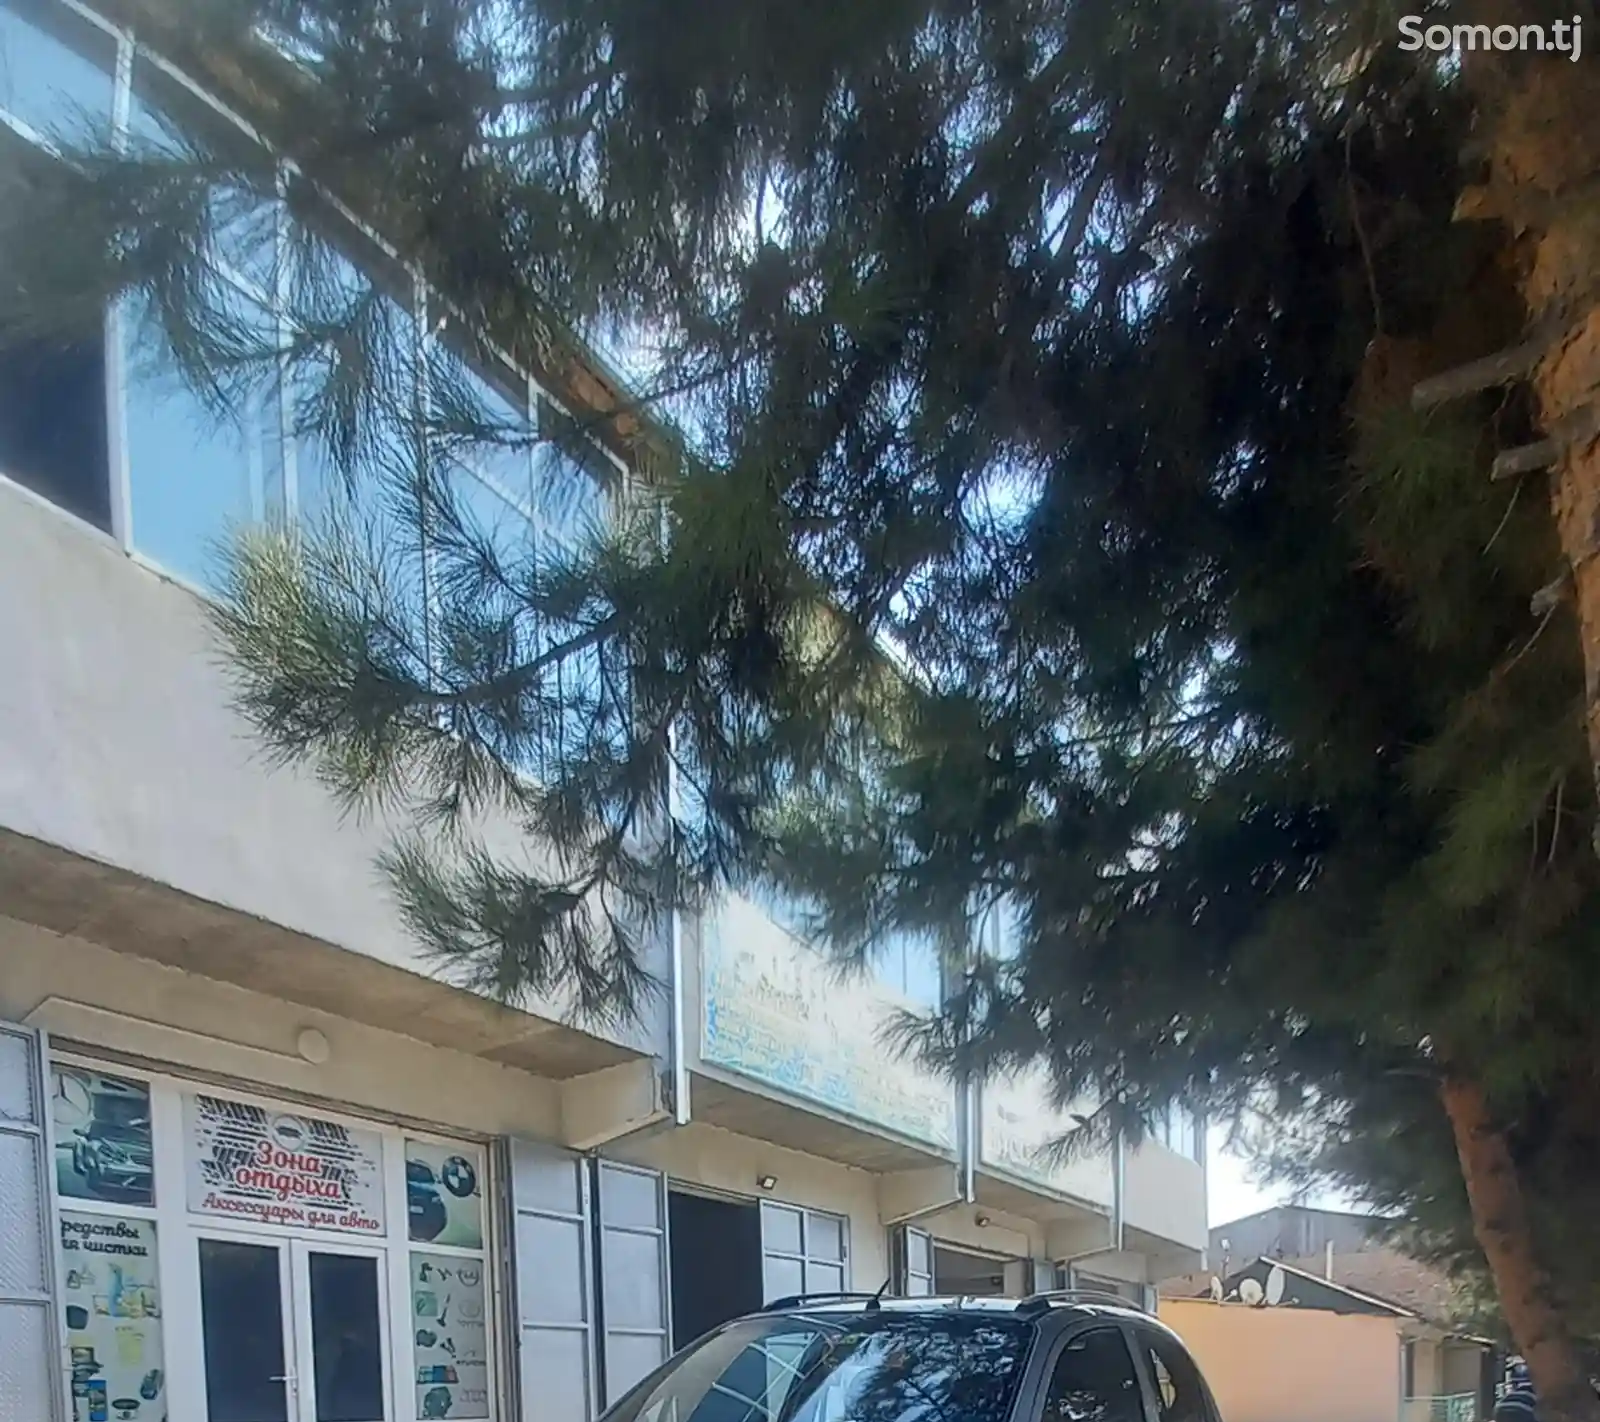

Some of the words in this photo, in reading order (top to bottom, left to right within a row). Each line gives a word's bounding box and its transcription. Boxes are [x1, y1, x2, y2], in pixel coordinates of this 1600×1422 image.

[257, 1140, 322, 1173] Зона
[235, 1167, 342, 1201] отдыха
[202, 1192, 304, 1225] Аксессуары
[307, 1209, 337, 1228] для
[339, 1211, 380, 1230] авто
